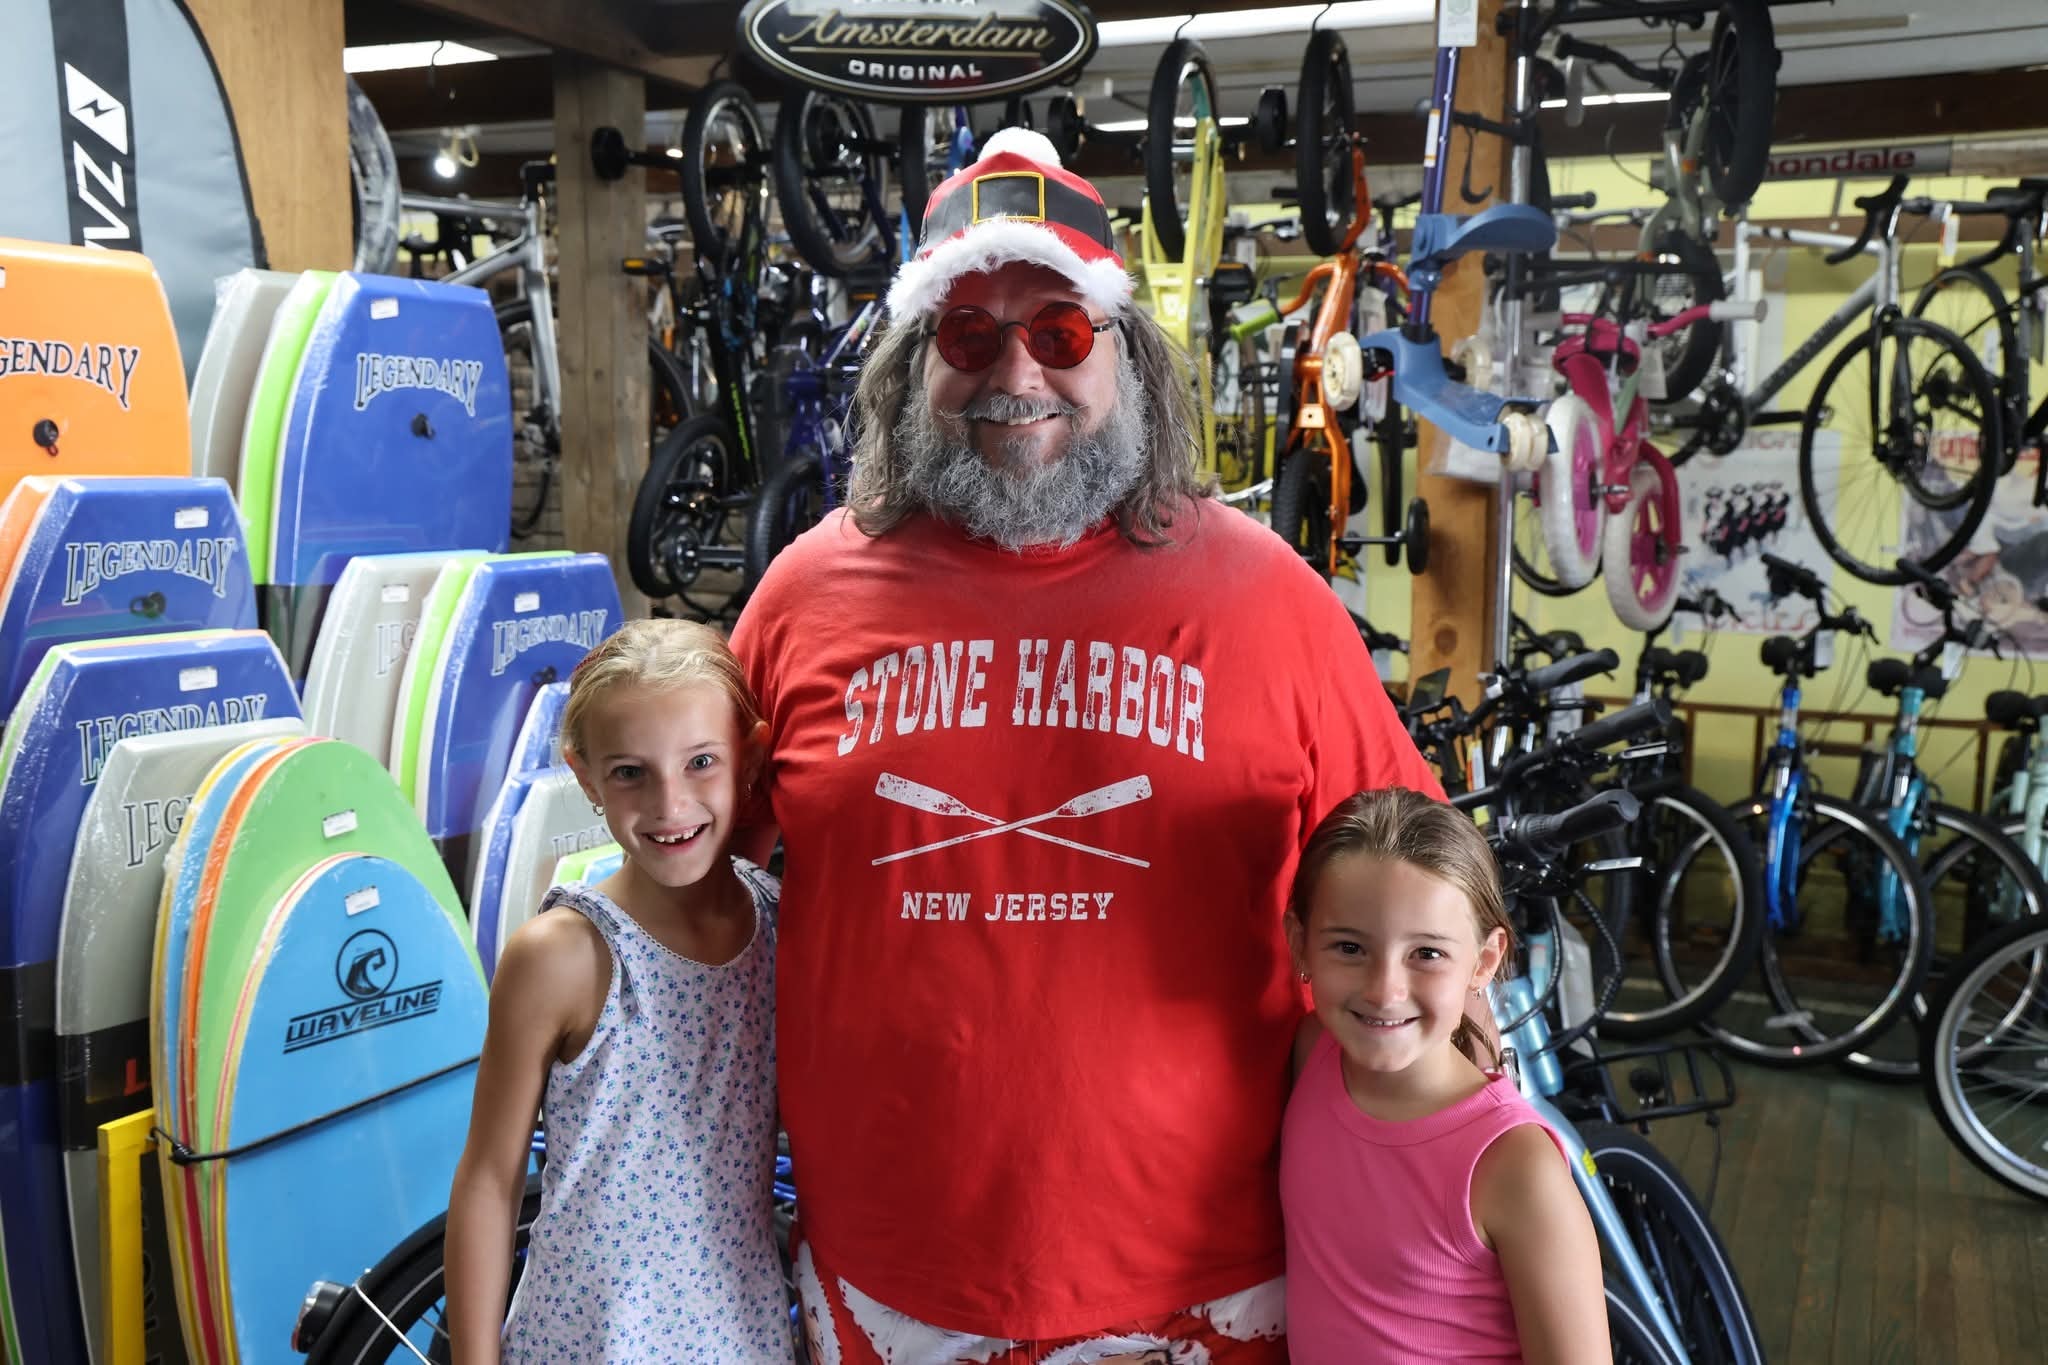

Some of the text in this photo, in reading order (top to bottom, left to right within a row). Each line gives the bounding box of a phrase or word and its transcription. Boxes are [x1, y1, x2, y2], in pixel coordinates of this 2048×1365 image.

[777, 9, 1055, 49] Amsterdam
[848, 59, 983, 81] ORIGINAL
[354, 353, 483, 417] LEGENDARY
[62, 537, 236, 606] LEGENDARY
[491, 608, 608, 676] LEGENDARY
[838, 638, 1205, 762] STONE HARBOR
[122, 795, 194, 870] LEG
[901, 891, 1115, 921] NEW JERSEY
[285, 986, 442, 1044] WAVELINE
